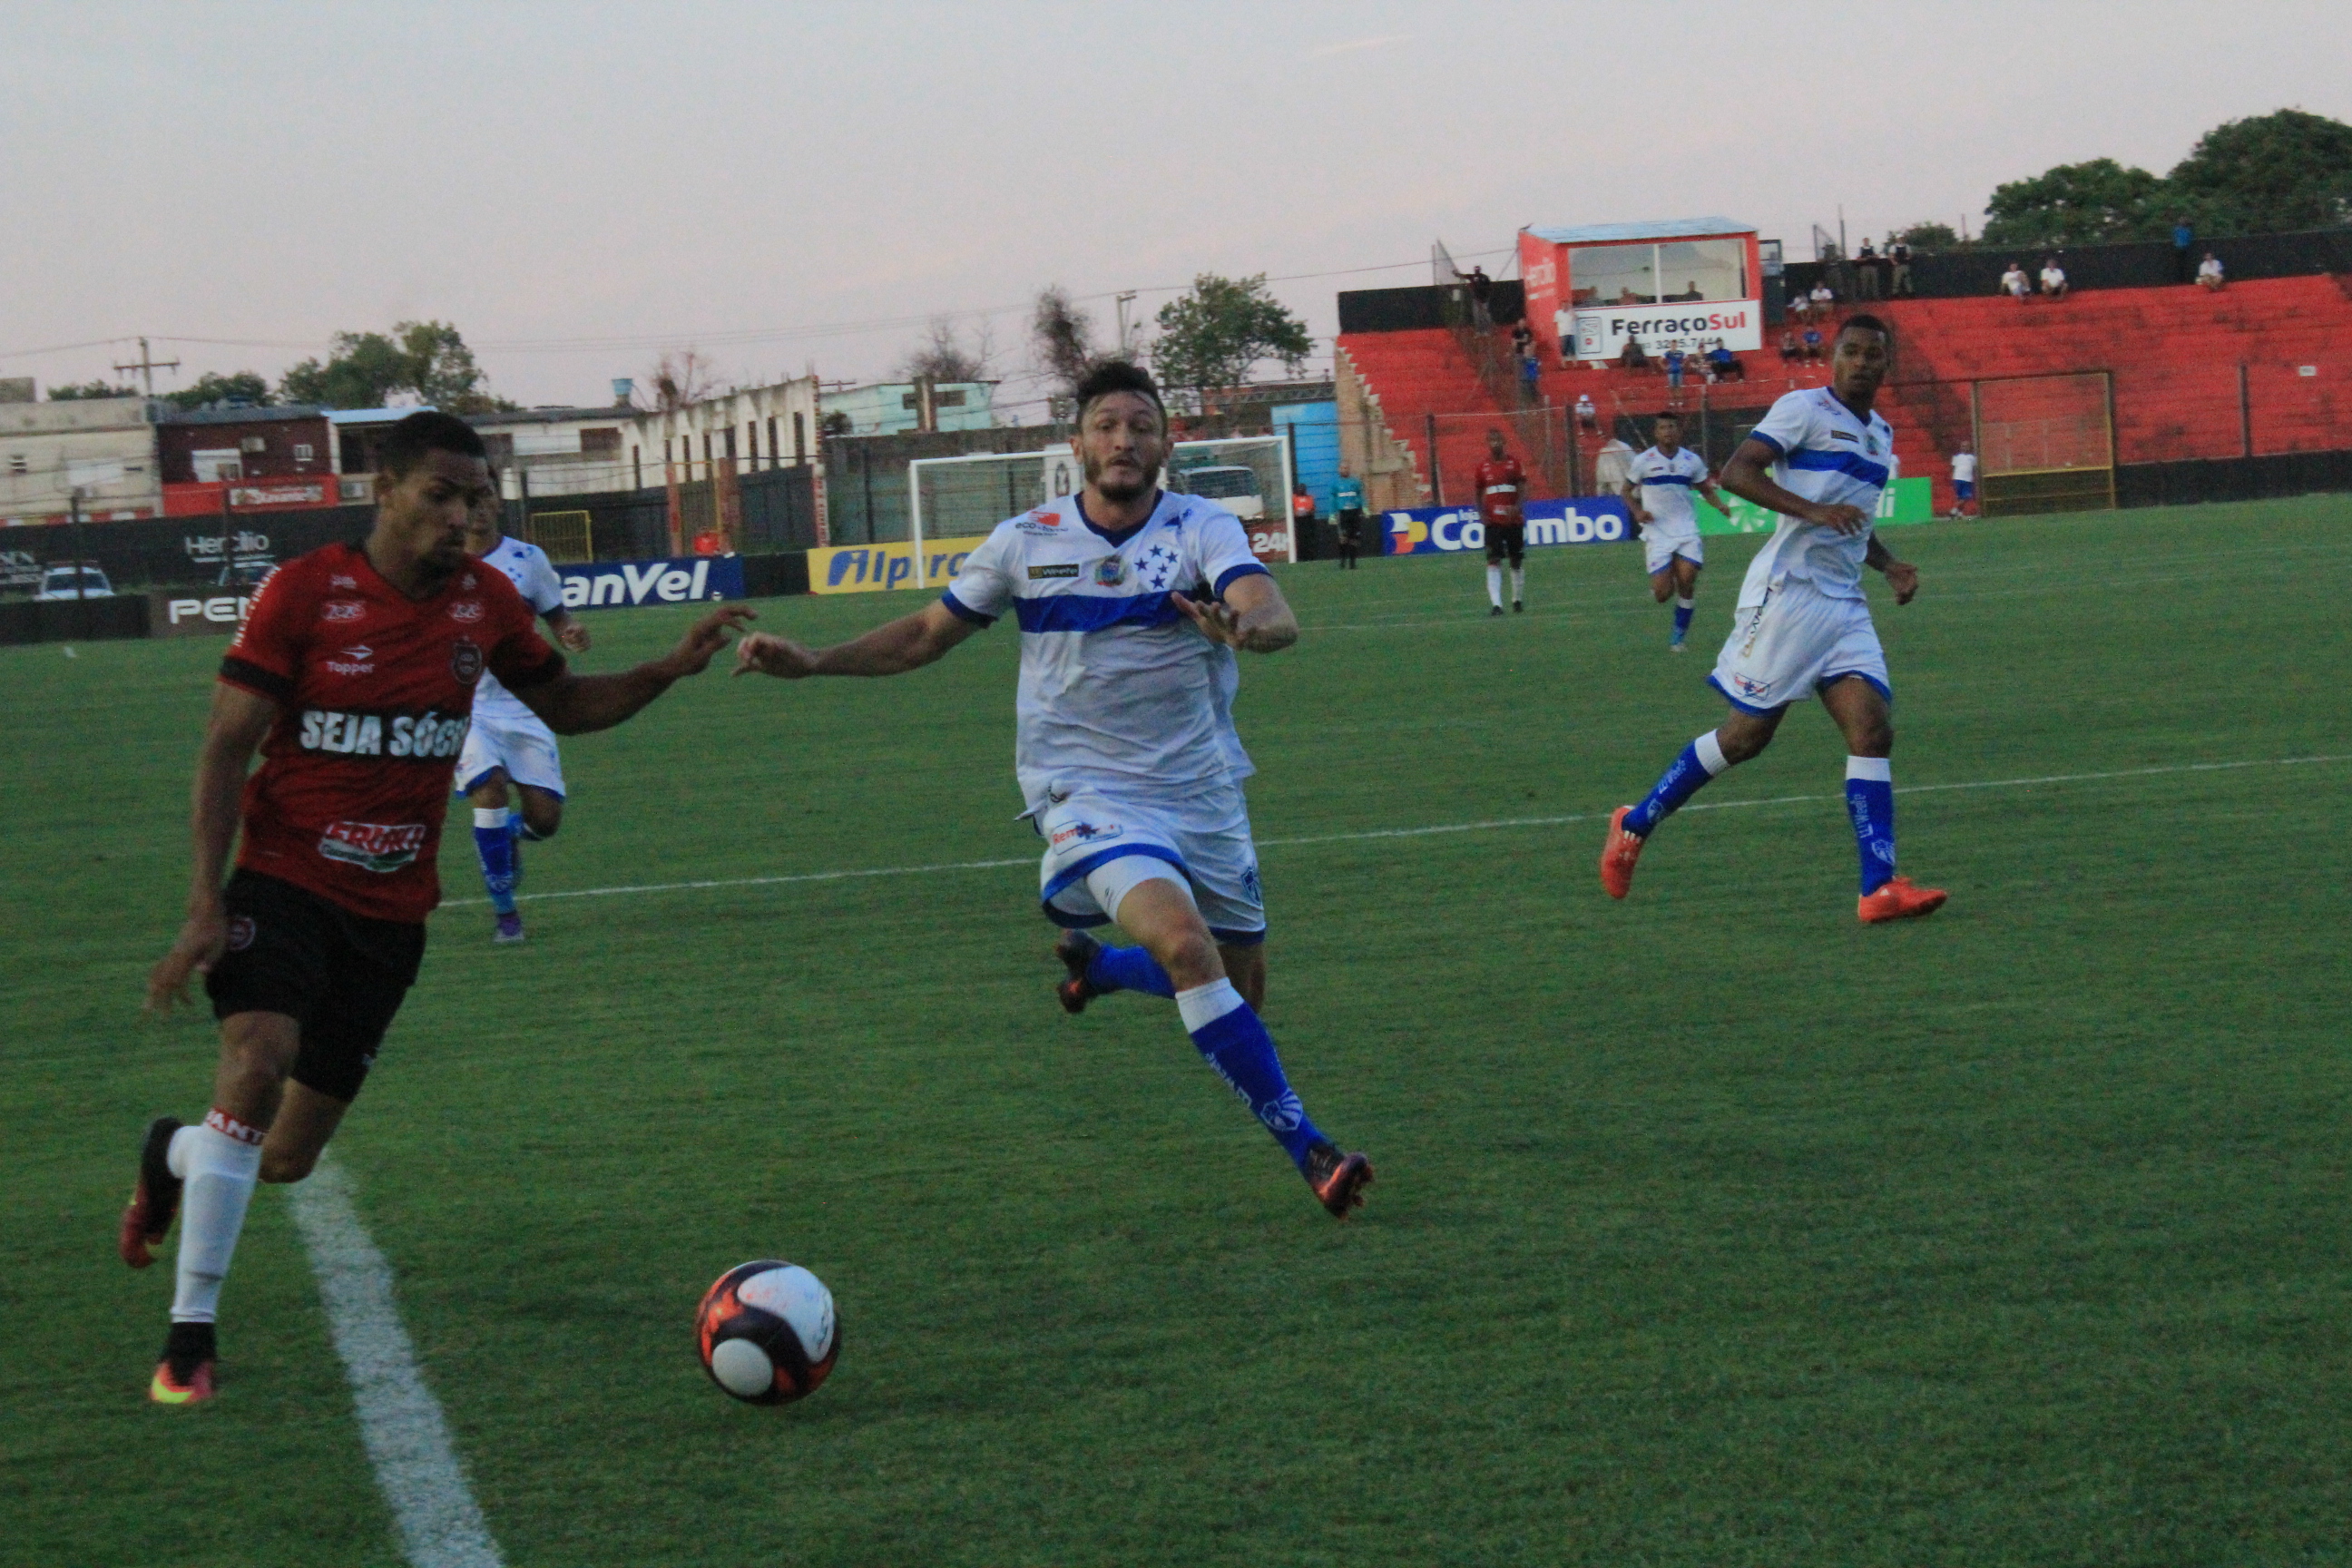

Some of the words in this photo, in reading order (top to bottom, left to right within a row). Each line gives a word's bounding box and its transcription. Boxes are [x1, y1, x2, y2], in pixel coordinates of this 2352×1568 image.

[1611, 311, 1747, 337] FerraçoSul
[558, 560, 710, 608] anVel
[327, 662, 375, 675] Topper
[300, 710, 382, 756] SEJA
